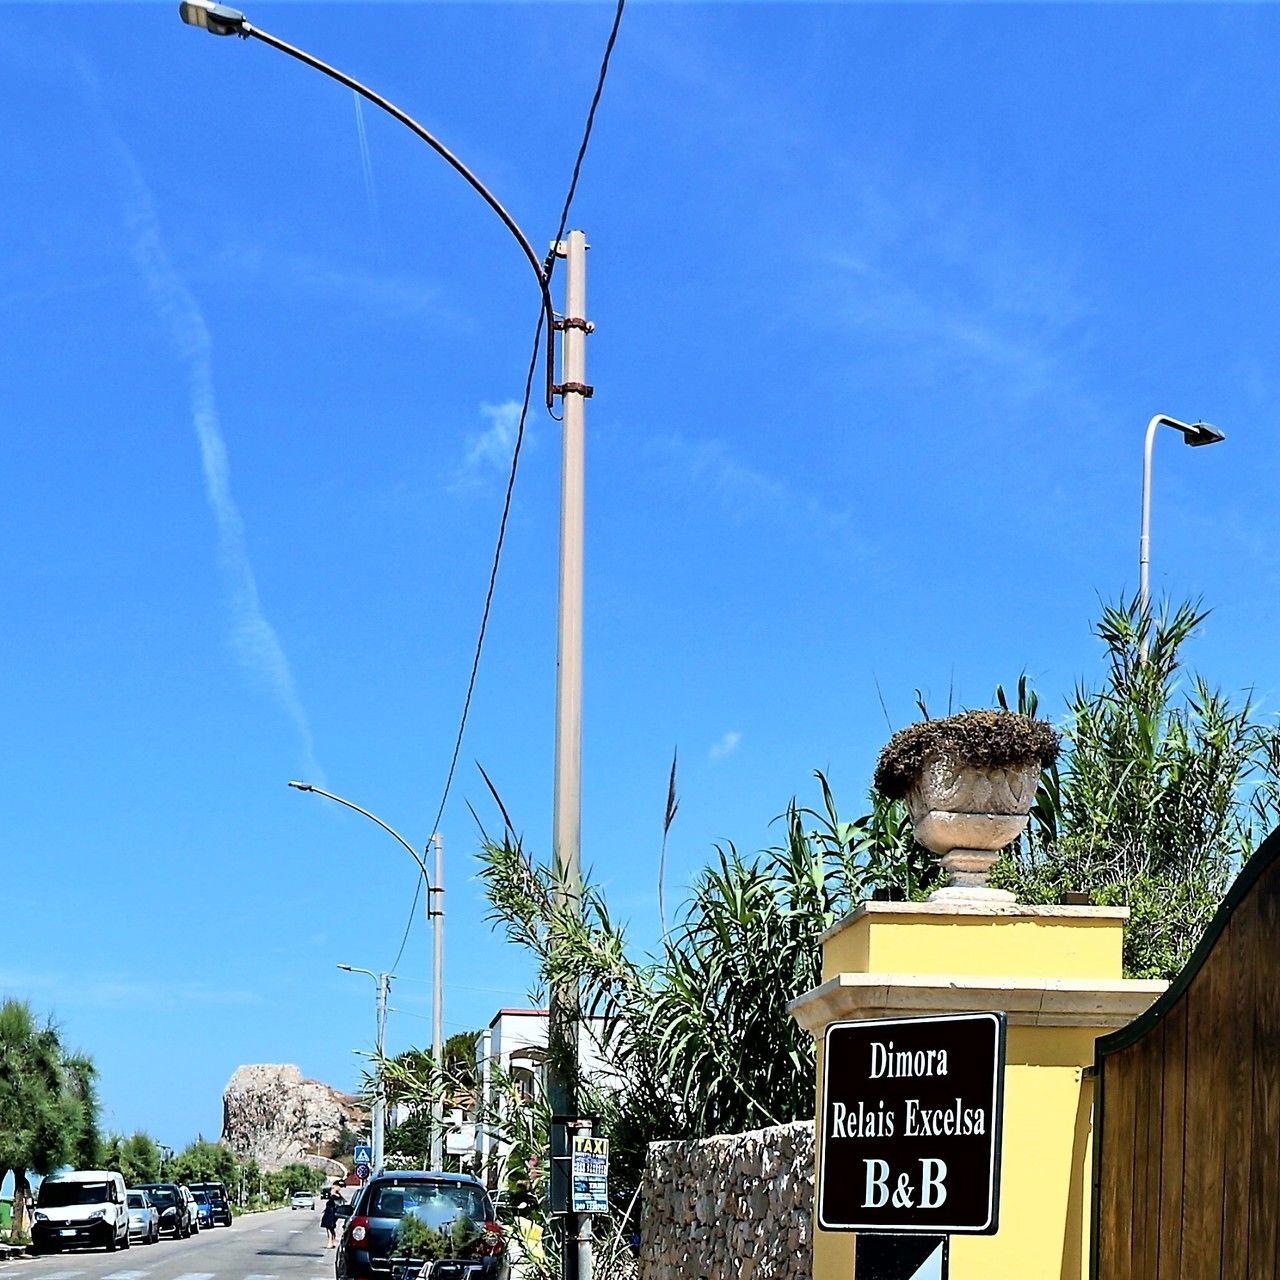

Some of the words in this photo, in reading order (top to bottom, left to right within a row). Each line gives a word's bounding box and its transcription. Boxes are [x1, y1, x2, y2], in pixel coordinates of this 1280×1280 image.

[868, 1041, 949, 1079] Dimora
[831, 1100, 895, 1138] Relais
[904, 1098, 986, 1137] Excelsa
[576, 1137, 608, 1155] TAXI
[860, 1158, 948, 1209] B&B
